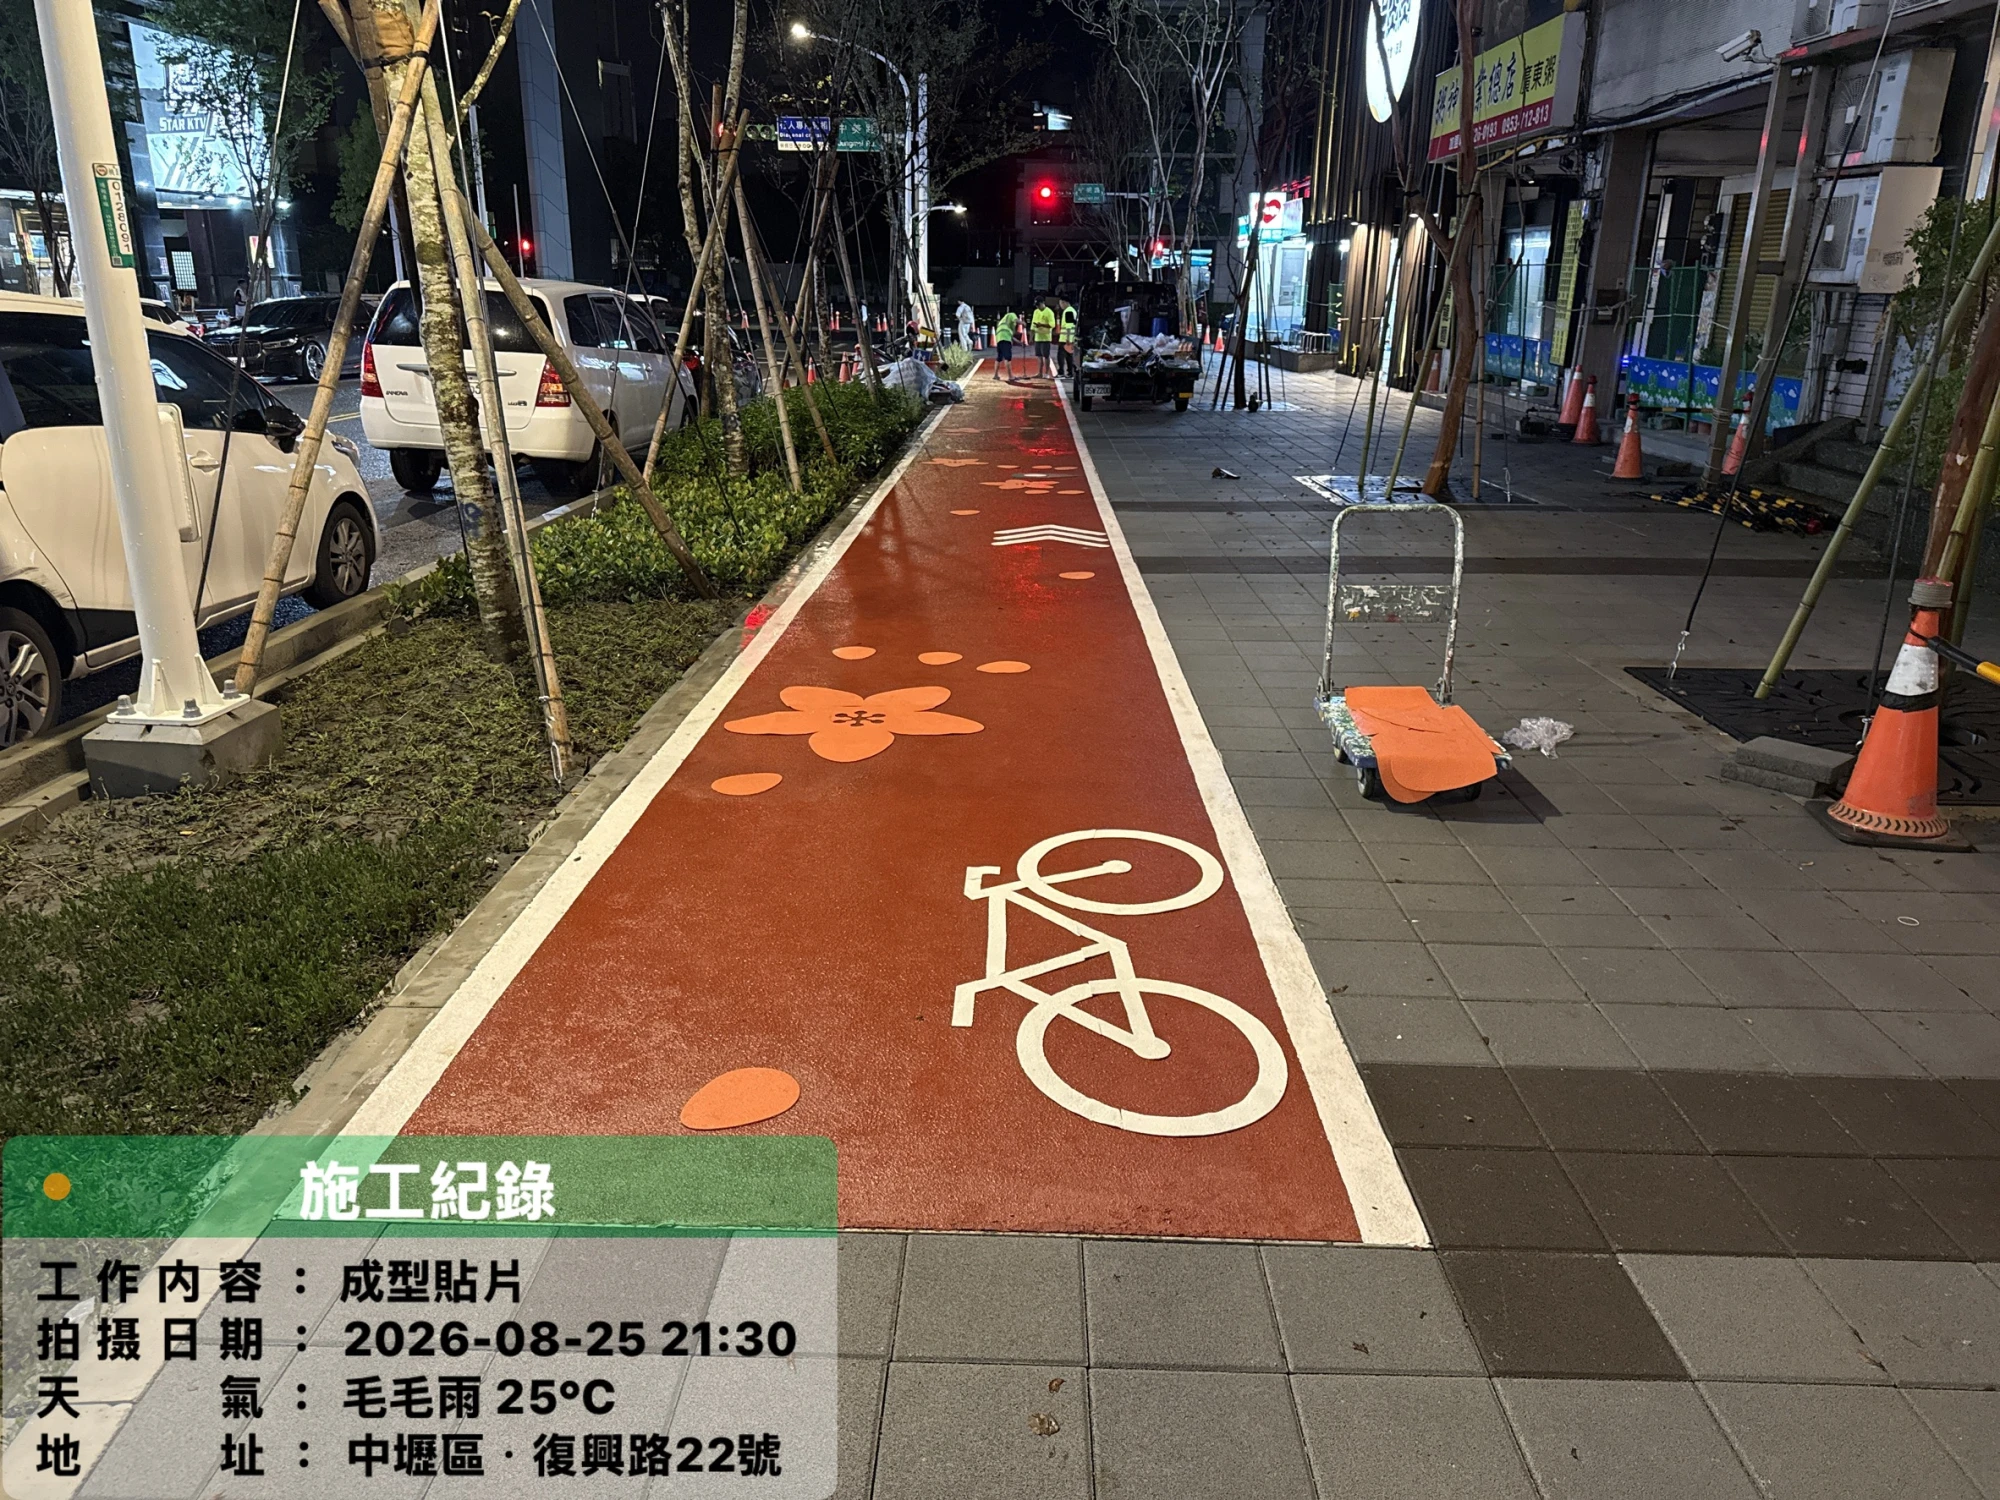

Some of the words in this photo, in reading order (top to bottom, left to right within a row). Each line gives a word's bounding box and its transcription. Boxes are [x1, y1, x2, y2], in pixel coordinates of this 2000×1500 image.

[1520, 54, 1557, 95] 廣東粥
[160, 117, 185, 131] STAR
[187, 117, 206, 130] KTV
[112, 181, 131, 253] 0128091
